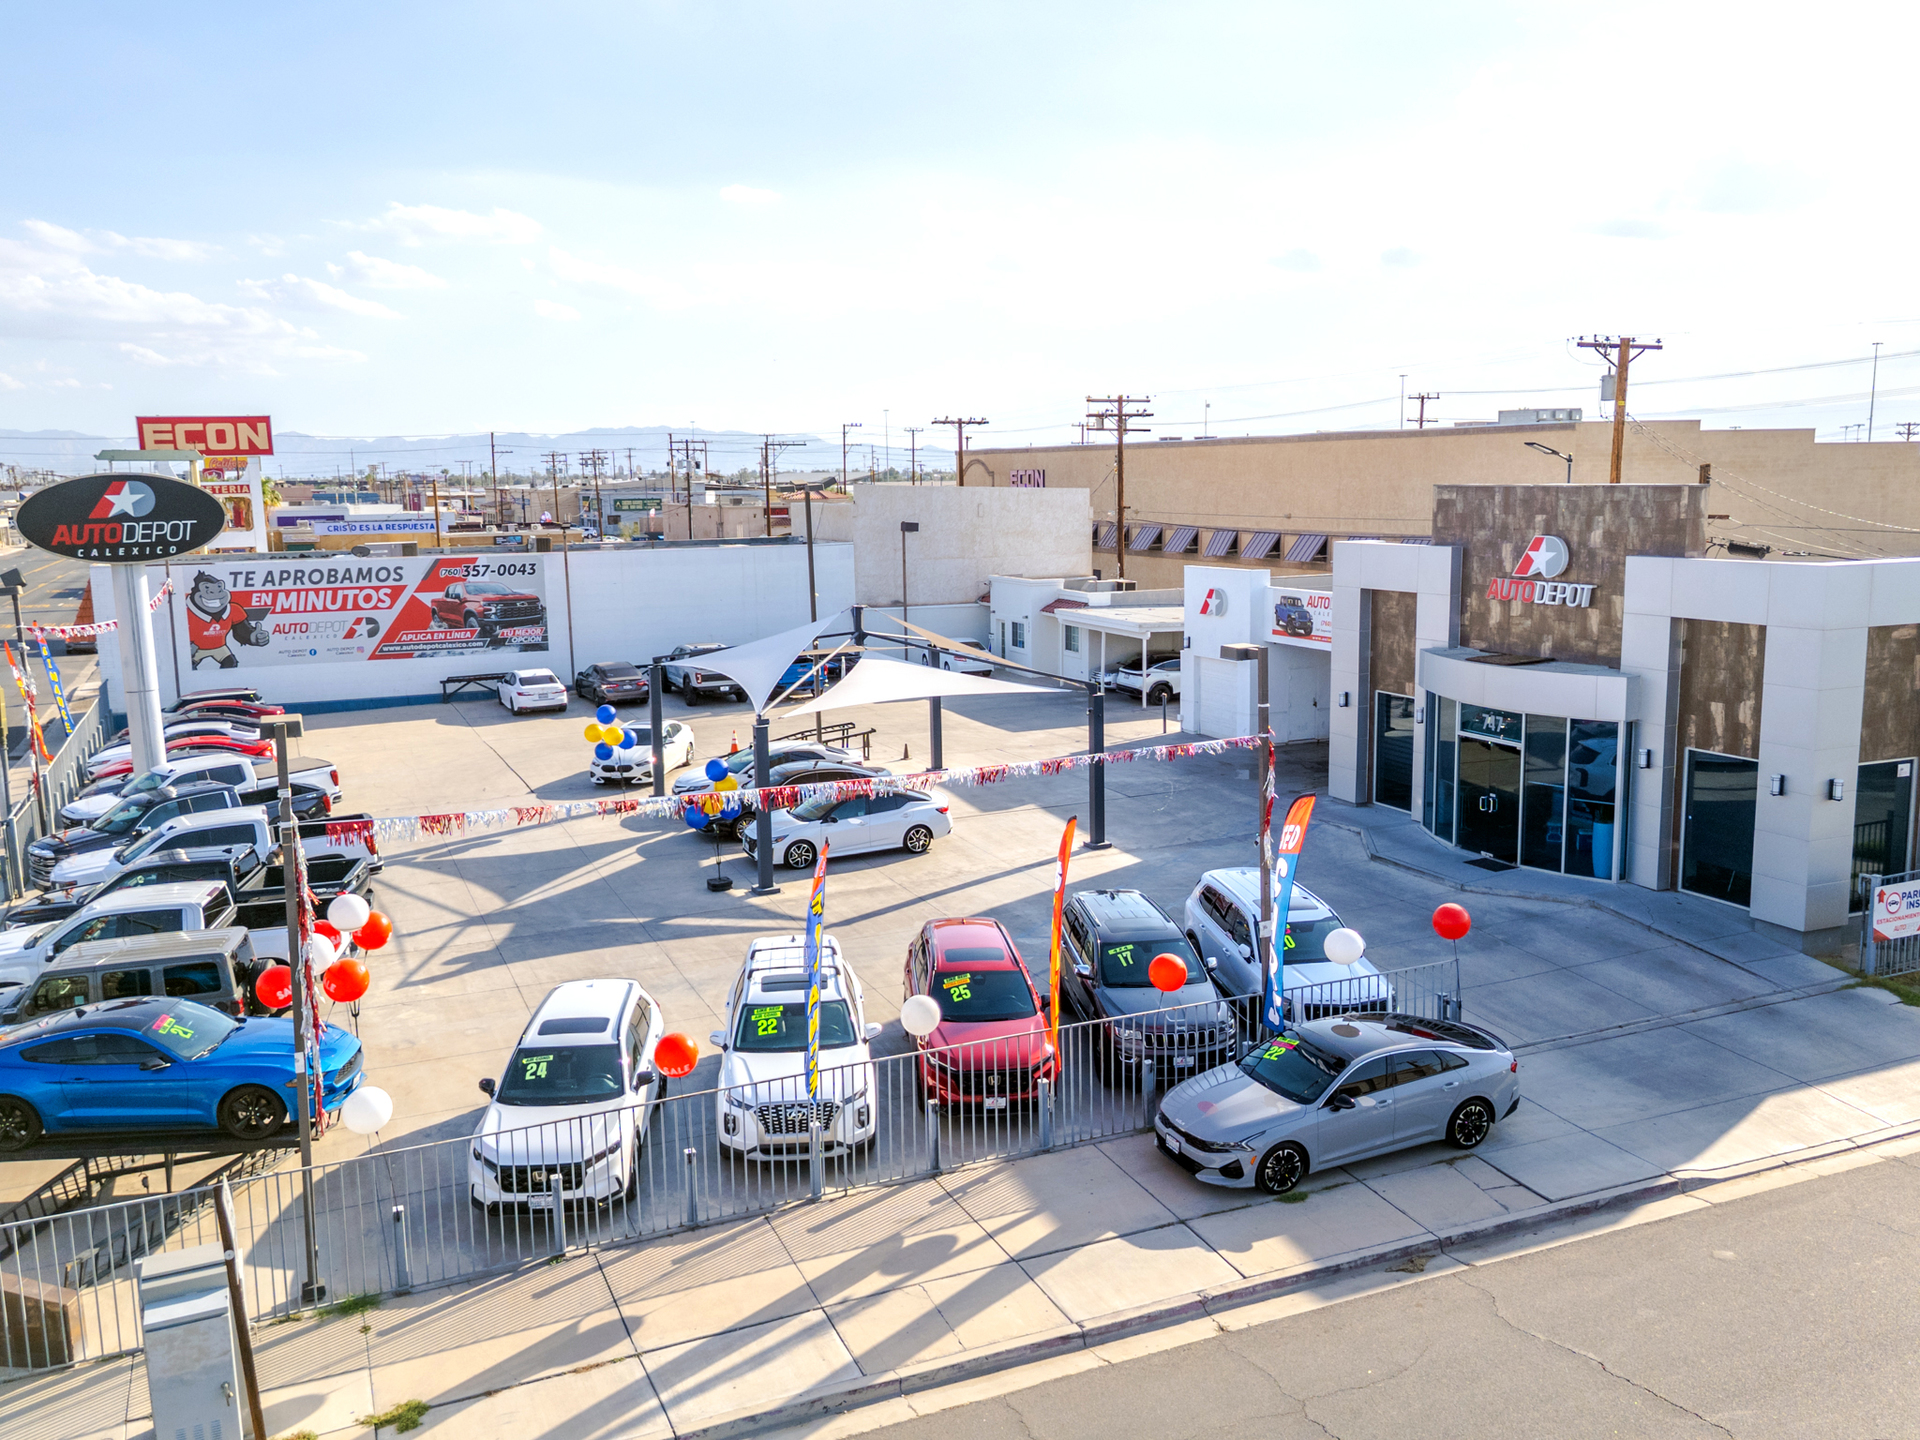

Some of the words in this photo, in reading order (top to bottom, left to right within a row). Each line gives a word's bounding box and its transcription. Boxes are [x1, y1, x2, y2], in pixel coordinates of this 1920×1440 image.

[143, 422, 270, 450] ECON
[1010, 470, 1046, 488] ECON
[51, 520, 197, 546] AUTODEPOT
[77, 546, 177, 558] CALEXICO
[229, 571, 256, 588] TE
[262, 566, 404, 587] APROBAMOS
[462, 563, 537, 577] 357-0043
[251, 592, 273, 606] EN
[275, 588, 392, 612] MINUTOS
[1486, 578, 1597, 608] AUTODEPOT
[272, 620, 348, 635] AUTODEPOT
[401, 633, 432, 641] APLICA
[446, 630, 471, 639] LÍNEA
[515, 628, 542, 636] MEJOR
[382, 641, 483, 652] www.autodepotcalexico.com
[1482, 713, 1504, 732] 747
[1117, 951, 1134, 967] 17
[950, 984, 971, 1002] 25
[170, 1025, 194, 1039] 21
[757, 1018, 778, 1036] 22
[1263, 1046, 1286, 1061] 22
[525, 1062, 547, 1080] 24
[663, 1064, 690, 1075] SALE
